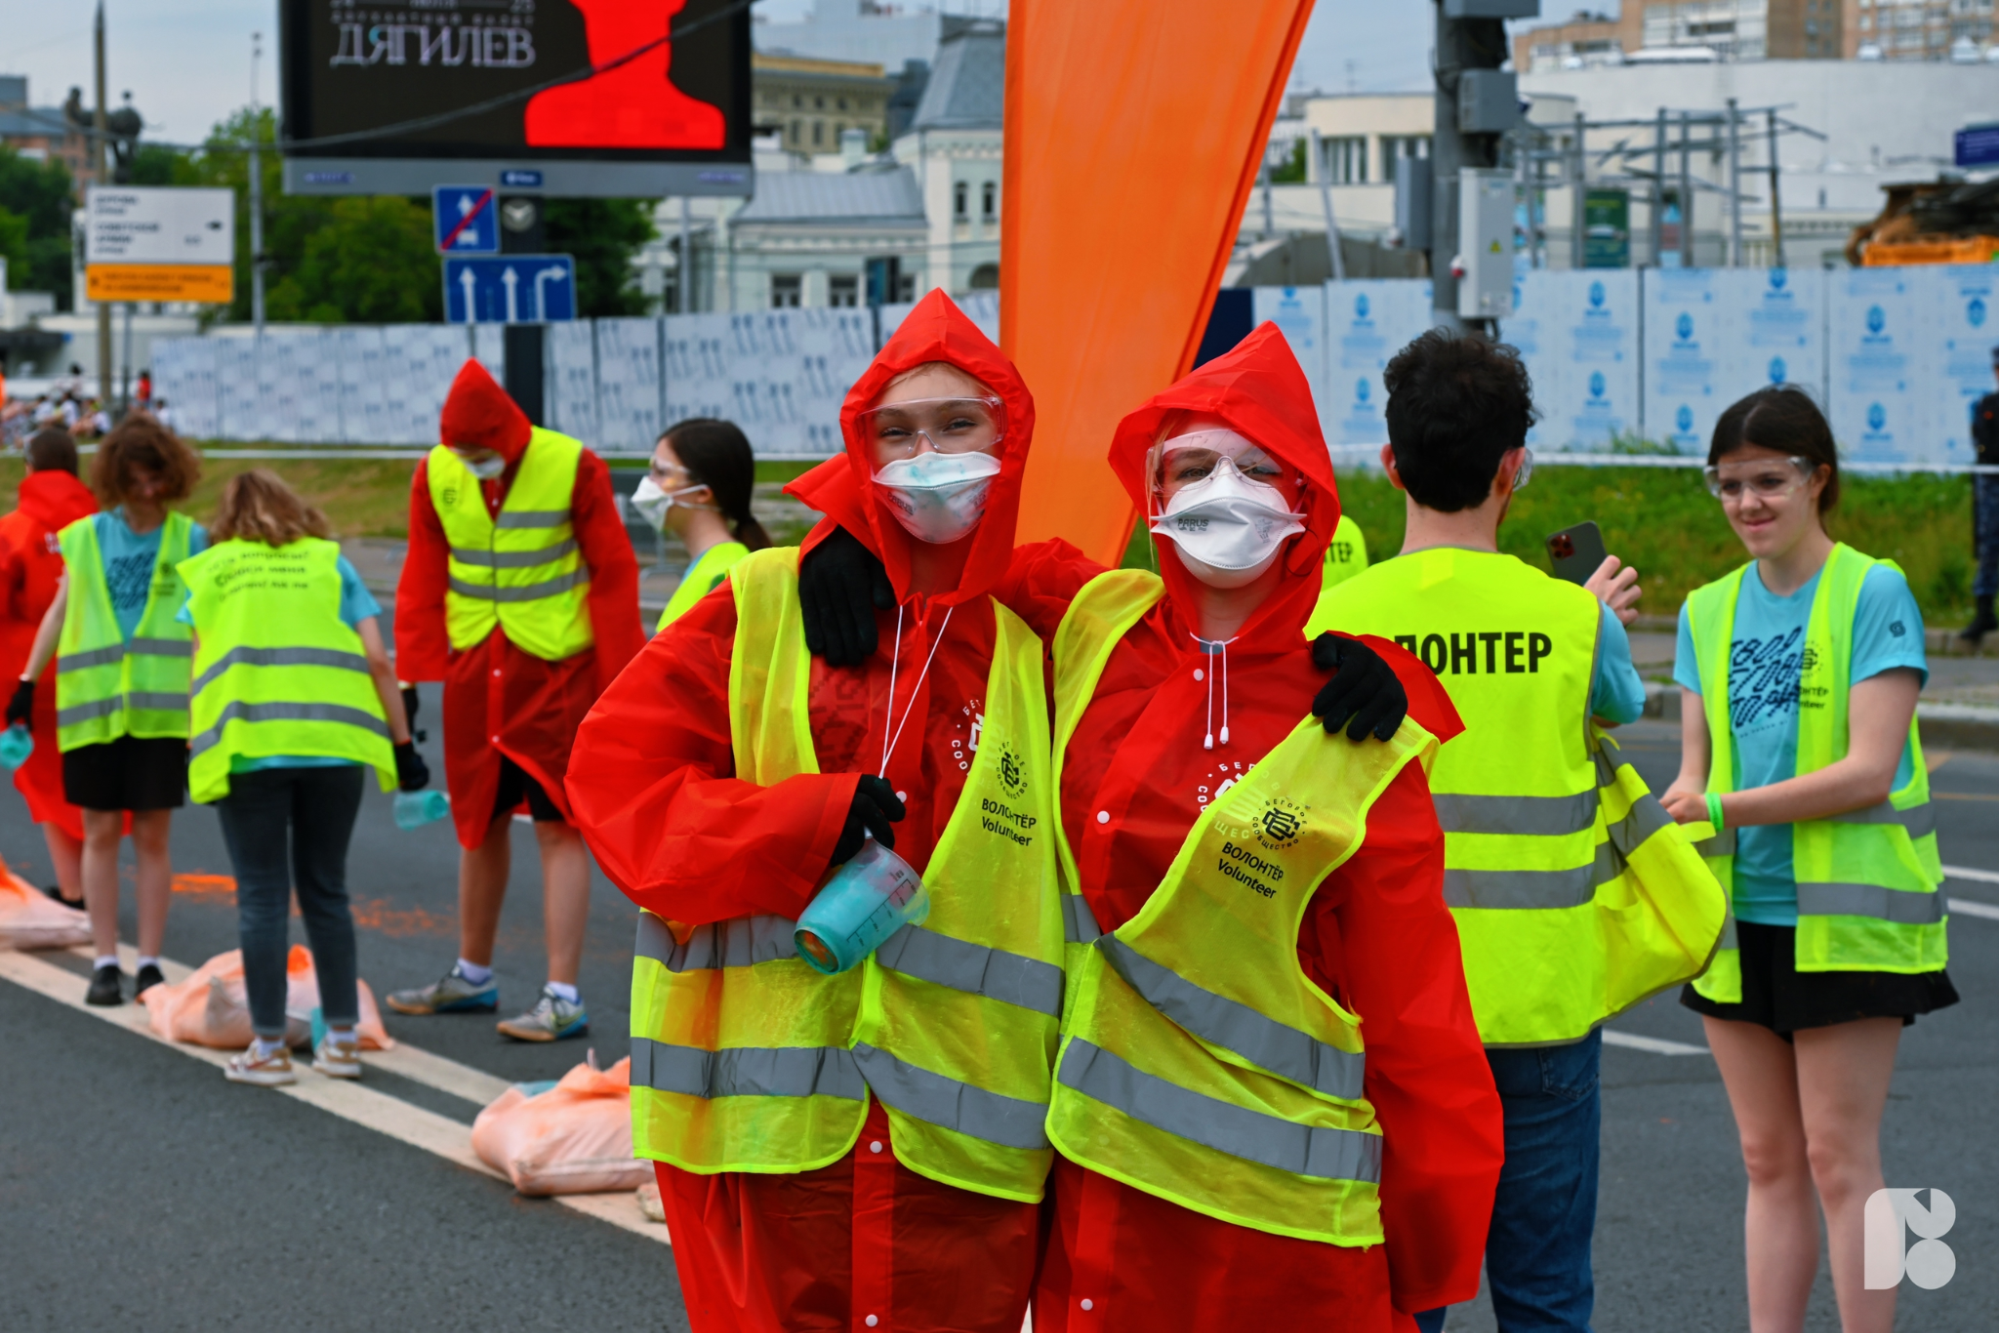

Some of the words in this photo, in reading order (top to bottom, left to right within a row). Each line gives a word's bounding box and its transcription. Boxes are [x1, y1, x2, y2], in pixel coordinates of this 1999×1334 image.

[329, 23, 537, 68] ДЯГИЛЕВ
[1177, 518, 1210, 528] PARUS
[982, 816, 1033, 847] Volunteer
[1252, 816, 1299, 851] СООБЩЕСТВО
[1218, 857, 1278, 899] Volunteer
[1221, 840, 1284, 882] ВОЛОНТЁР
